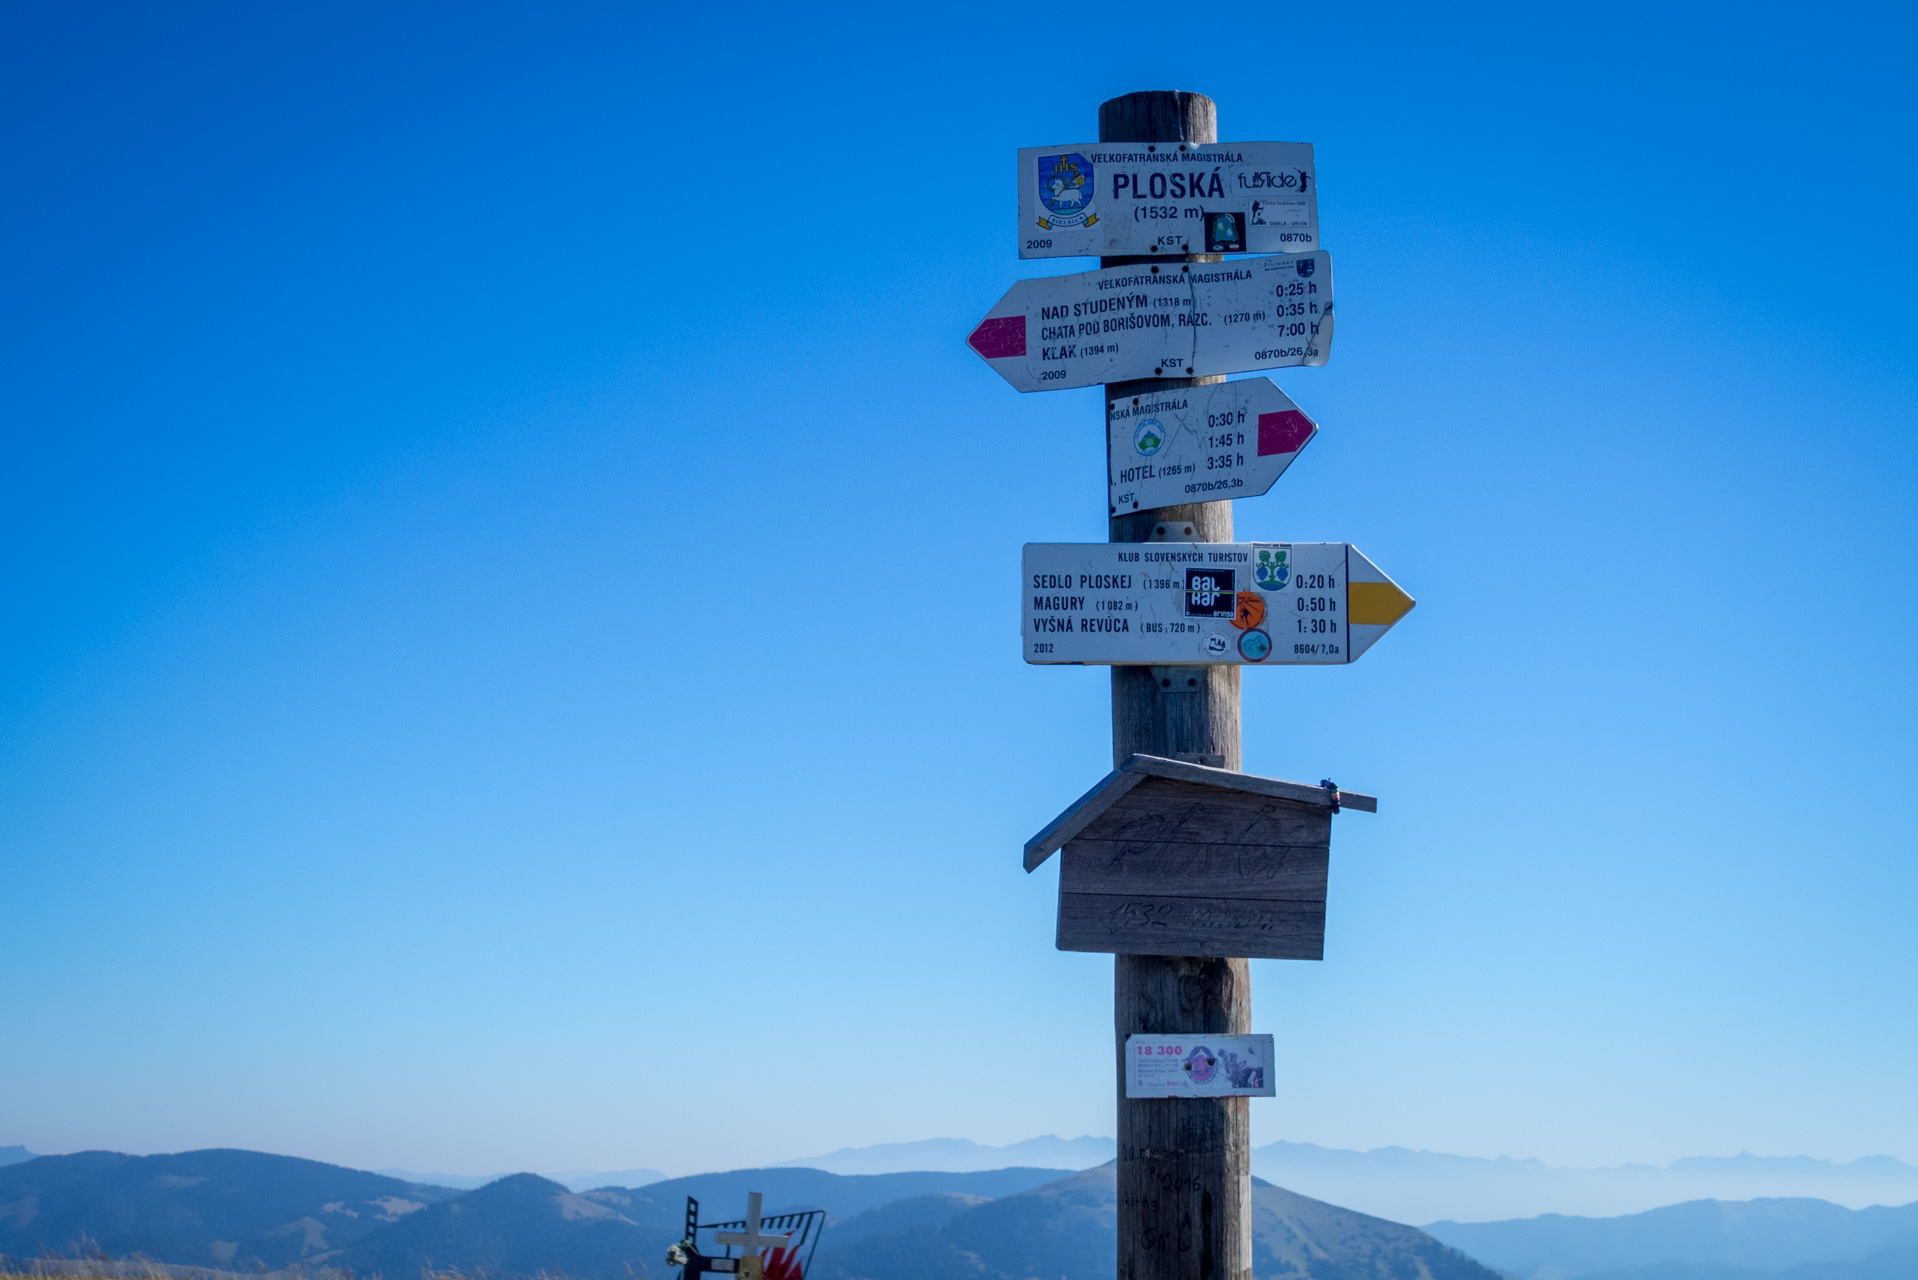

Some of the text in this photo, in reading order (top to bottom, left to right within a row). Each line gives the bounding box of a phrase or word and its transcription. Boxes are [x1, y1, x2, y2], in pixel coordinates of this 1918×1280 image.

[1091, 152, 1243, 163] VEĽKOFATRANSKÁ MAGISTRÁLA
[1113, 166, 1225, 199] PLOSKÁ
[1134, 205, 1205, 222] (1532 m)
[1027, 239, 1052, 249] 2009
[1157, 236, 1182, 246] KST
[1280, 232, 1312, 243] 0870b
[1189, 269, 1252, 283] MAGISTRÁLA
[1276, 281, 1317, 297] 0:25 h
[1041, 305, 1069, 320] NAD
[1074, 292, 1147, 316] STUDENÝM
[1153, 297, 1179, 309] (1318
[1277, 302, 1317, 317] 0:35 h
[1042, 310, 1265, 340] CHATA POD BORIŠOVOM, RÁZC. (1270 m)
[1278, 322, 1319, 337] 7:00 h
[1081, 345, 1104, 358] (1394
[1107, 343, 1119, 354] m)
[1161, 359, 1183, 367] KST
[1042, 370, 1066, 380] 2009
[1133, 399, 1188, 416] MAGISTRÁLA
[1208, 411, 1245, 428] 0:30 h
[1208, 432, 1244, 449] 1:45 h
[1207, 454, 1244, 470] 3:35 h
[1120, 463, 1195, 483] HOTEL (1265 m)
[1184, 479, 1243, 494] 0870b/26,3b
[1119, 493, 1135, 504] KST
[1118, 551, 1248, 562] KLUB SLOVENSKÝCH TURISTOV
[1033, 575, 1072, 589] SEDLO
[1080, 575, 1132, 589] PLOSKEJ
[1296, 575, 1335, 589] 0:20 h
[1034, 596, 1084, 610] MAGURY
[1297, 598, 1336, 611] 0:50 h
[1034, 616, 1073, 632] VYŠNÁ
[1081, 616, 1129, 632] REVÚCA
[1297, 619, 1336, 633] 1:30 h
[1034, 644, 1053, 653] 2012
[1137, 1046, 1182, 1056] 18 300
